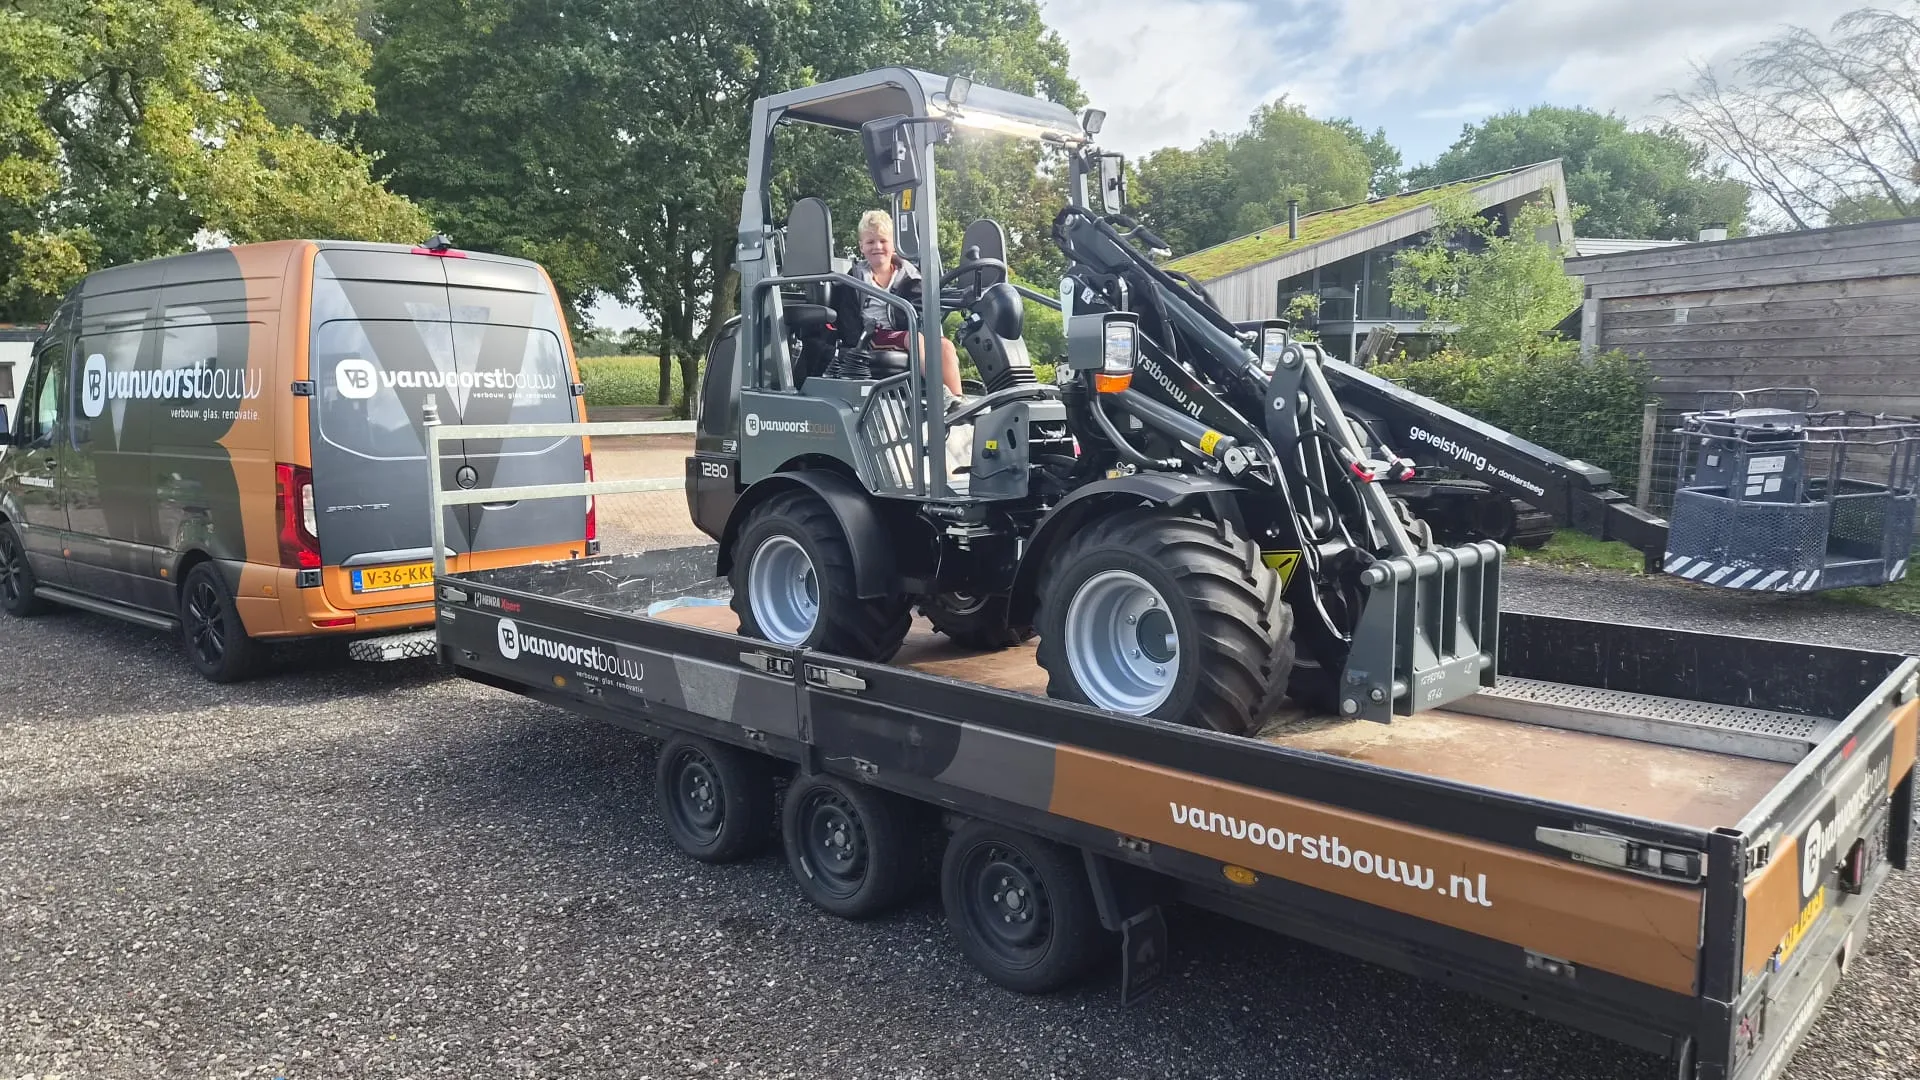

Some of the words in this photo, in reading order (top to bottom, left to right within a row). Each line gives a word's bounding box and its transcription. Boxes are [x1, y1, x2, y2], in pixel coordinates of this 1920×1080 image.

[108, 359, 262, 400] vanvoorstbouw
[379, 368, 556, 389] vanvoorstbouw
[701, 462, 728, 479] 1280
[1409, 426, 1488, 471] gevelstyling
[1487, 463, 1499, 475] by
[1498, 469, 1545, 497] donkersteeg
[519, 633, 644, 681] vanvoorstbouw
[1169, 802, 1493, 907] vanvoorstbouw.nl
